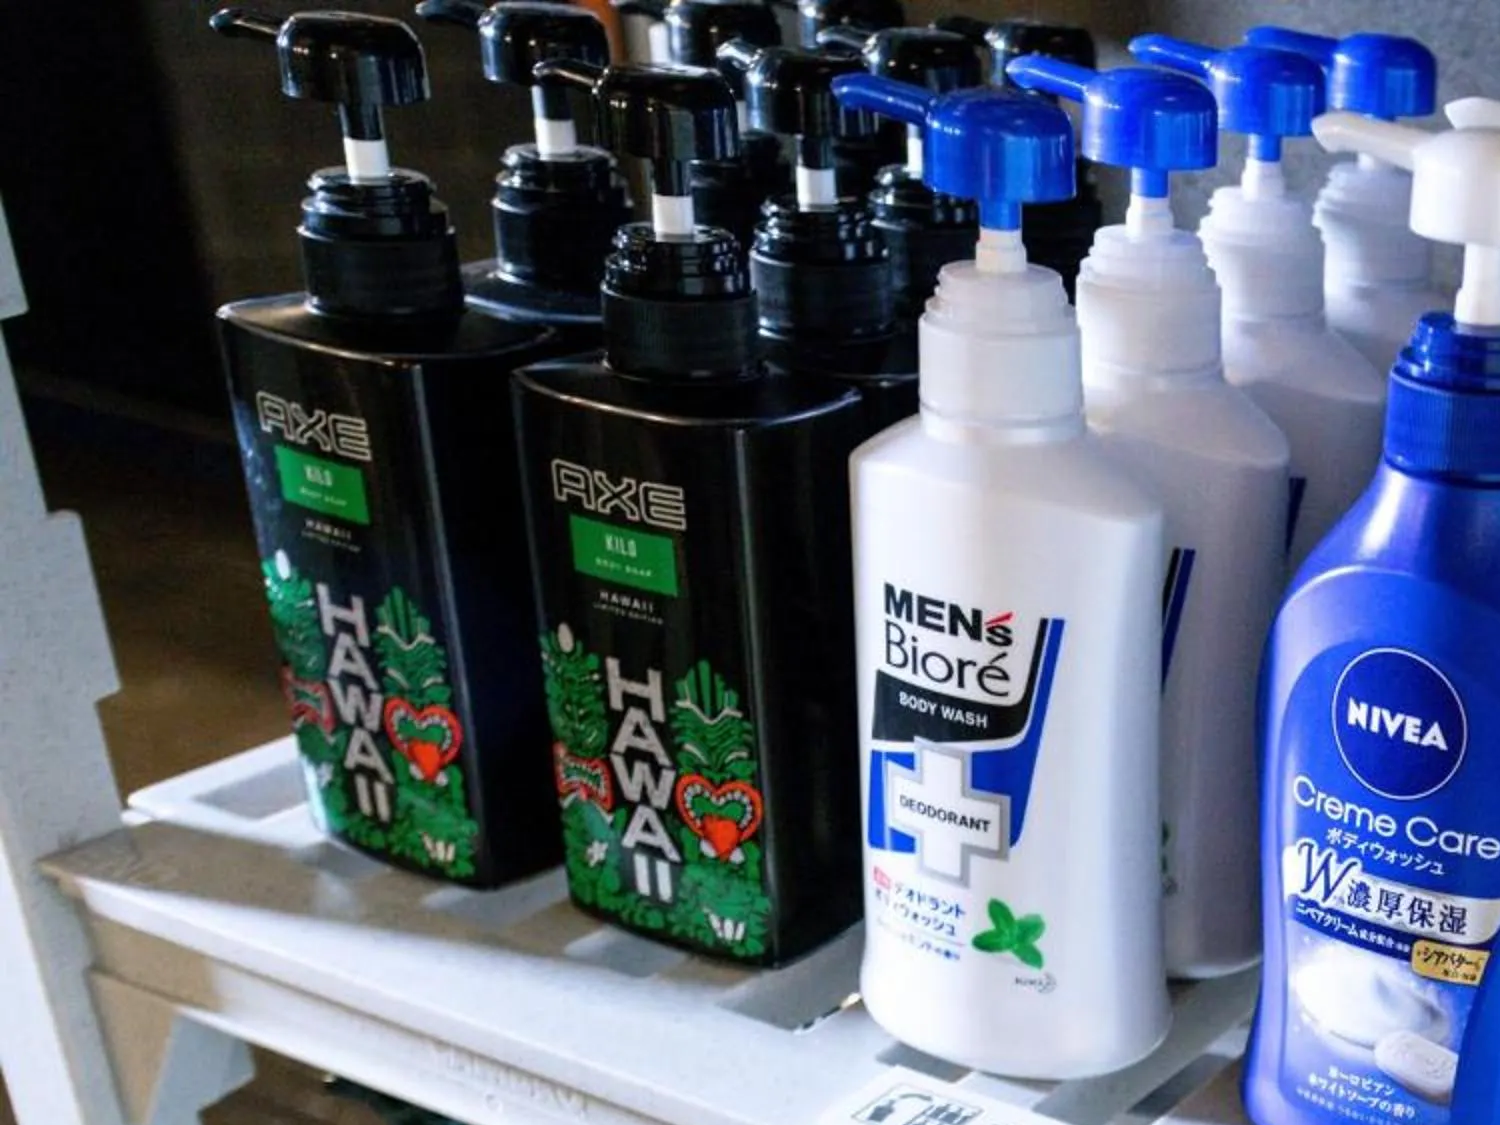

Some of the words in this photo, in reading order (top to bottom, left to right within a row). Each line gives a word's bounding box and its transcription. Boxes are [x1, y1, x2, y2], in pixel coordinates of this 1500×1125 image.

[256, 391, 372, 461] AXE
[551, 458, 687, 531] AXE
[604, 534, 637, 558] KILO
[600, 589, 654, 613] HAWAII
[884, 618, 1011, 698] Bioré
[316, 582, 391, 823] HAWAII
[898, 691, 939, 716] BODY
[940, 703, 989, 729] WASH
[1347, 697, 1449, 752] NIVEA
[605, 656, 682, 903] HAWAII
[1292, 774, 1398, 838] Creme
[898, 794, 991, 834] DEODORANT
